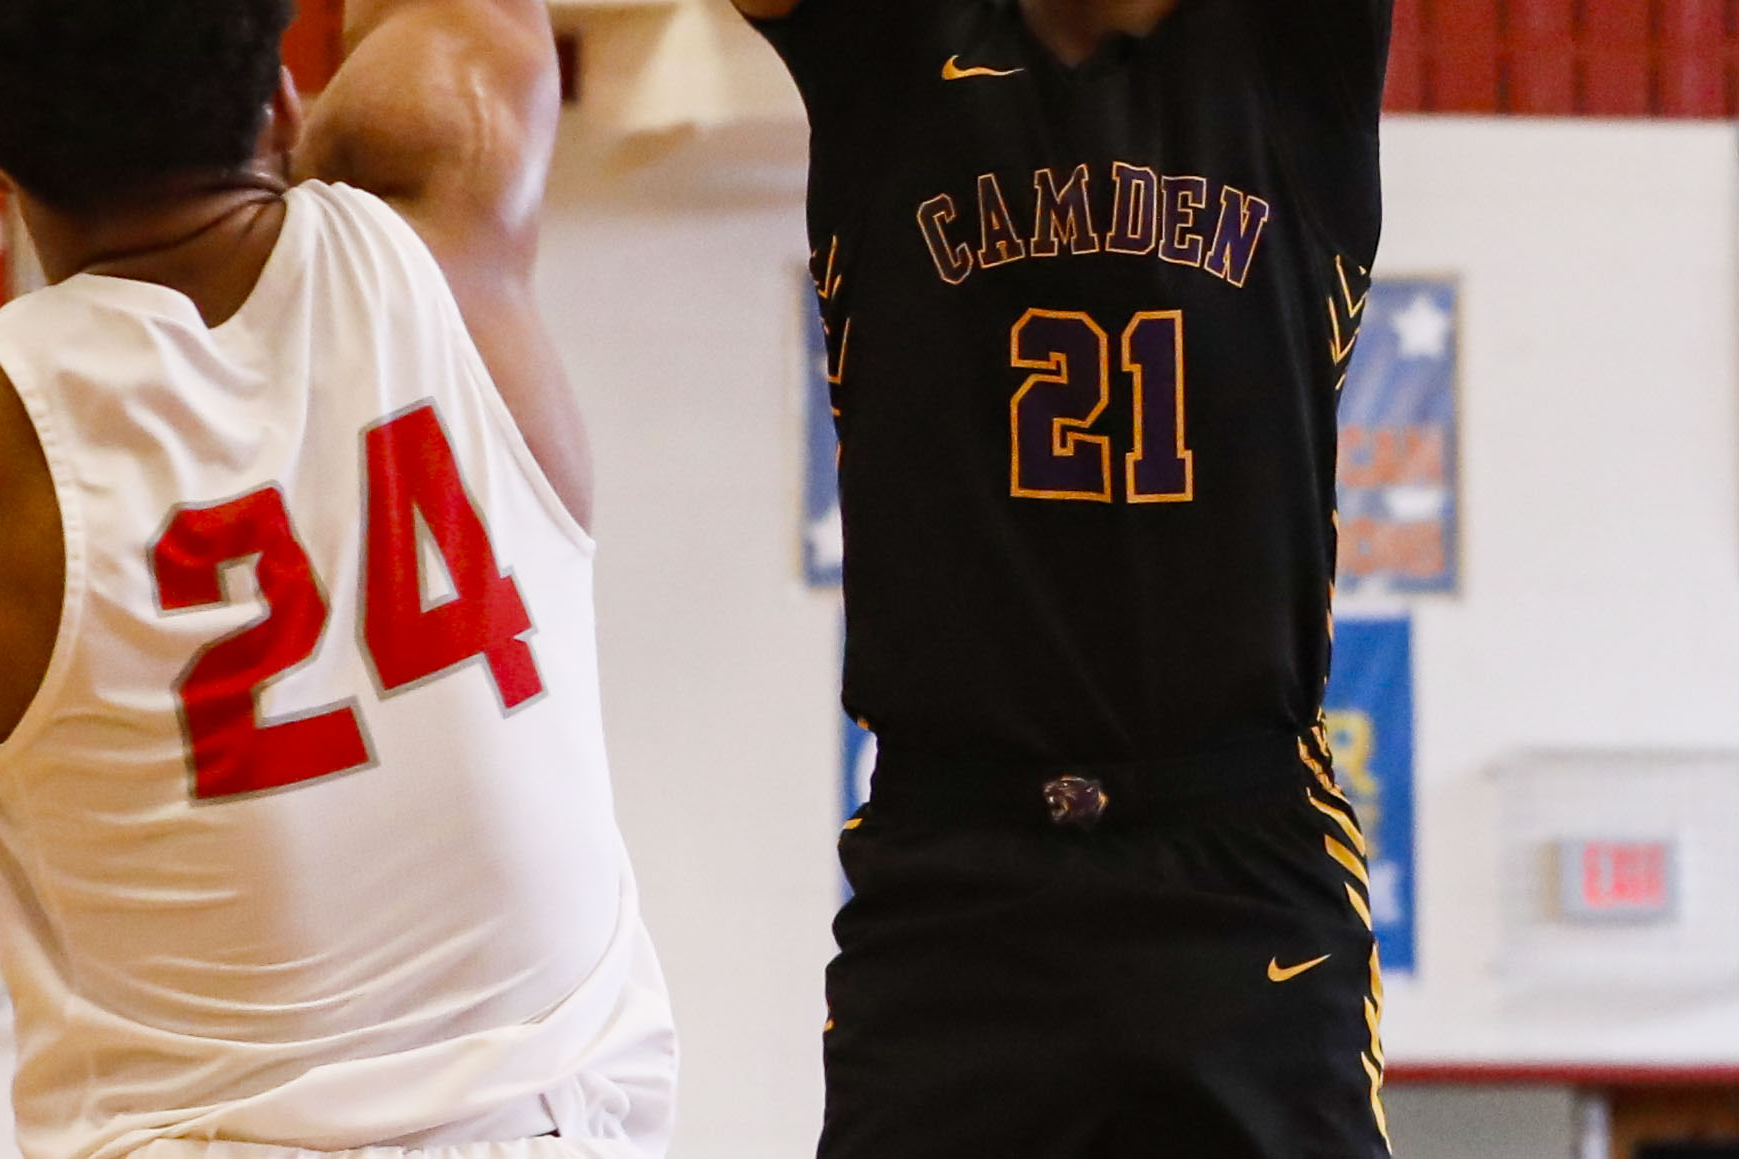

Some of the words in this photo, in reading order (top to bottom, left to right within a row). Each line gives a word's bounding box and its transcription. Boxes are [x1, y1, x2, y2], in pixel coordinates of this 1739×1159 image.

[916, 160, 1270, 288] CAMDEN
[1009, 307, 1194, 504] 21
[145, 394, 549, 808] 24
